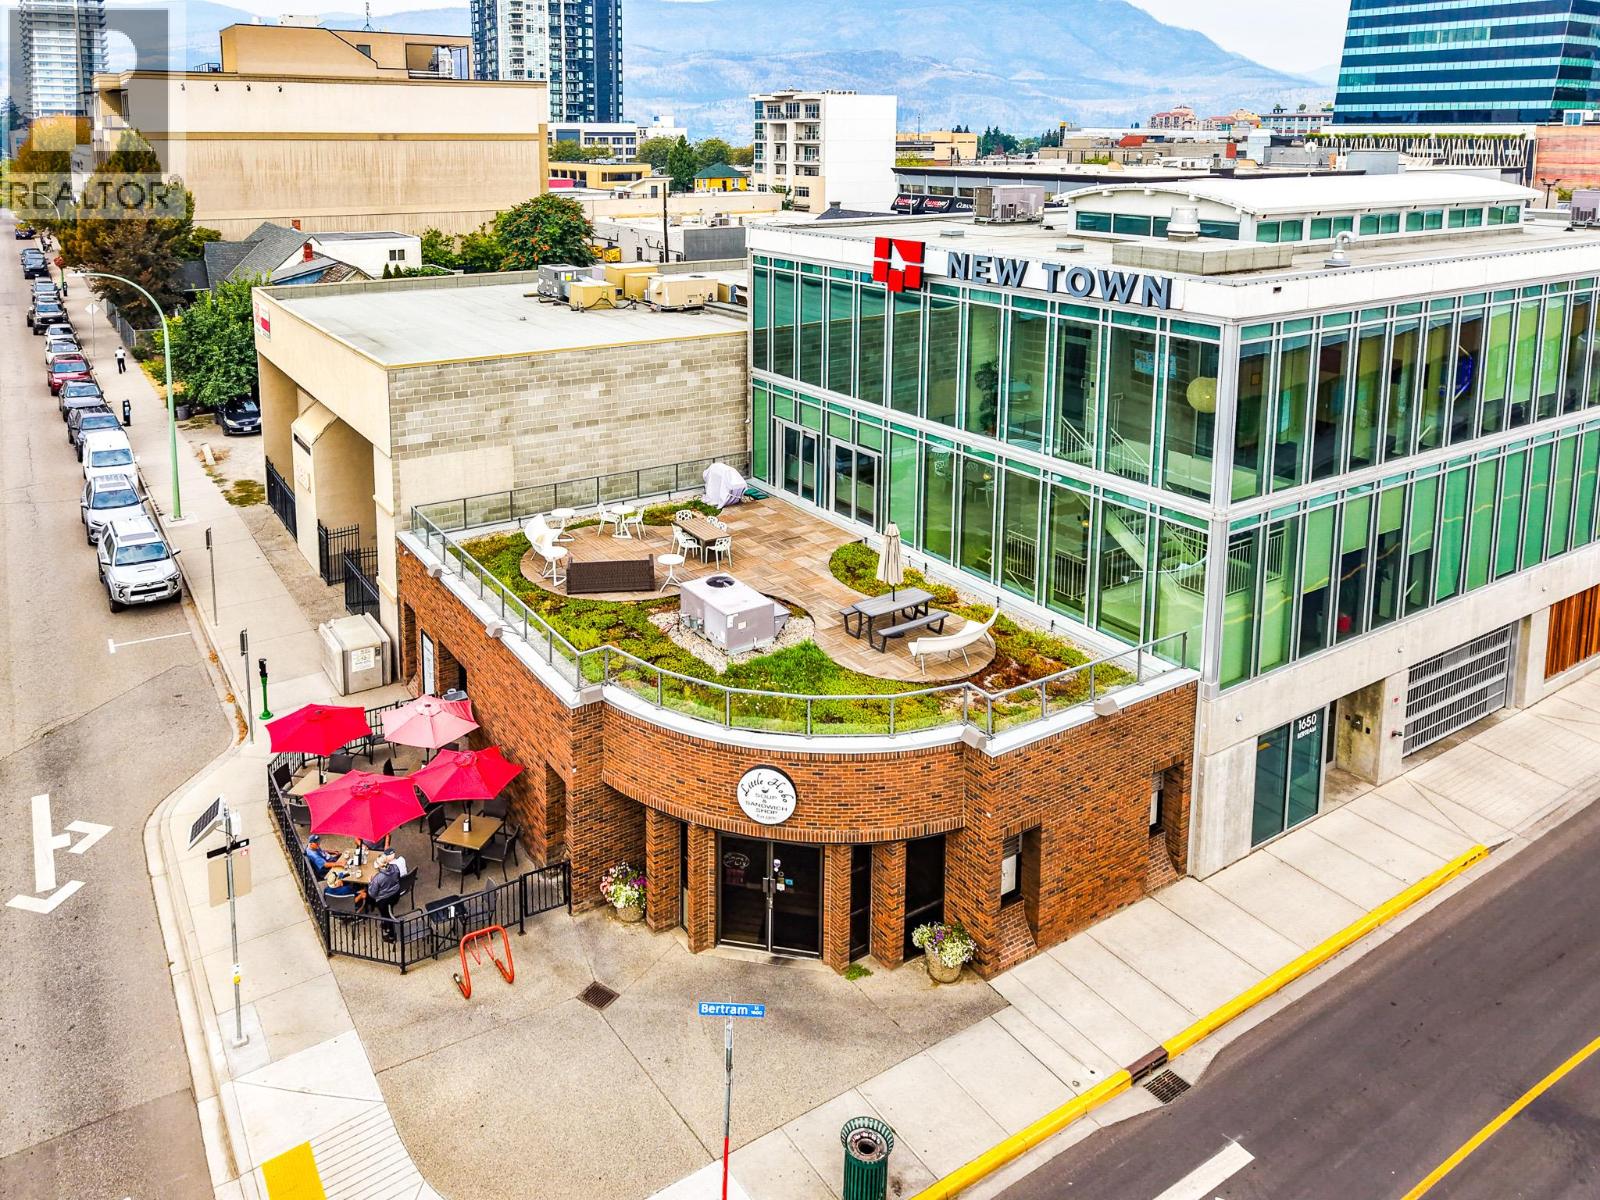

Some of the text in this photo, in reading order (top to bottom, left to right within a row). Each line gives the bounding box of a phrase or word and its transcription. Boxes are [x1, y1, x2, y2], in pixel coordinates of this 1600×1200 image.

[947, 252, 1173, 310] NEW TOWN
[1298, 714, 1317, 731] 1650
[741, 772, 794, 803] Little Hobo
[745, 800, 788, 811] SANDWICH
[701, 1004, 748, 1014] Bertram
